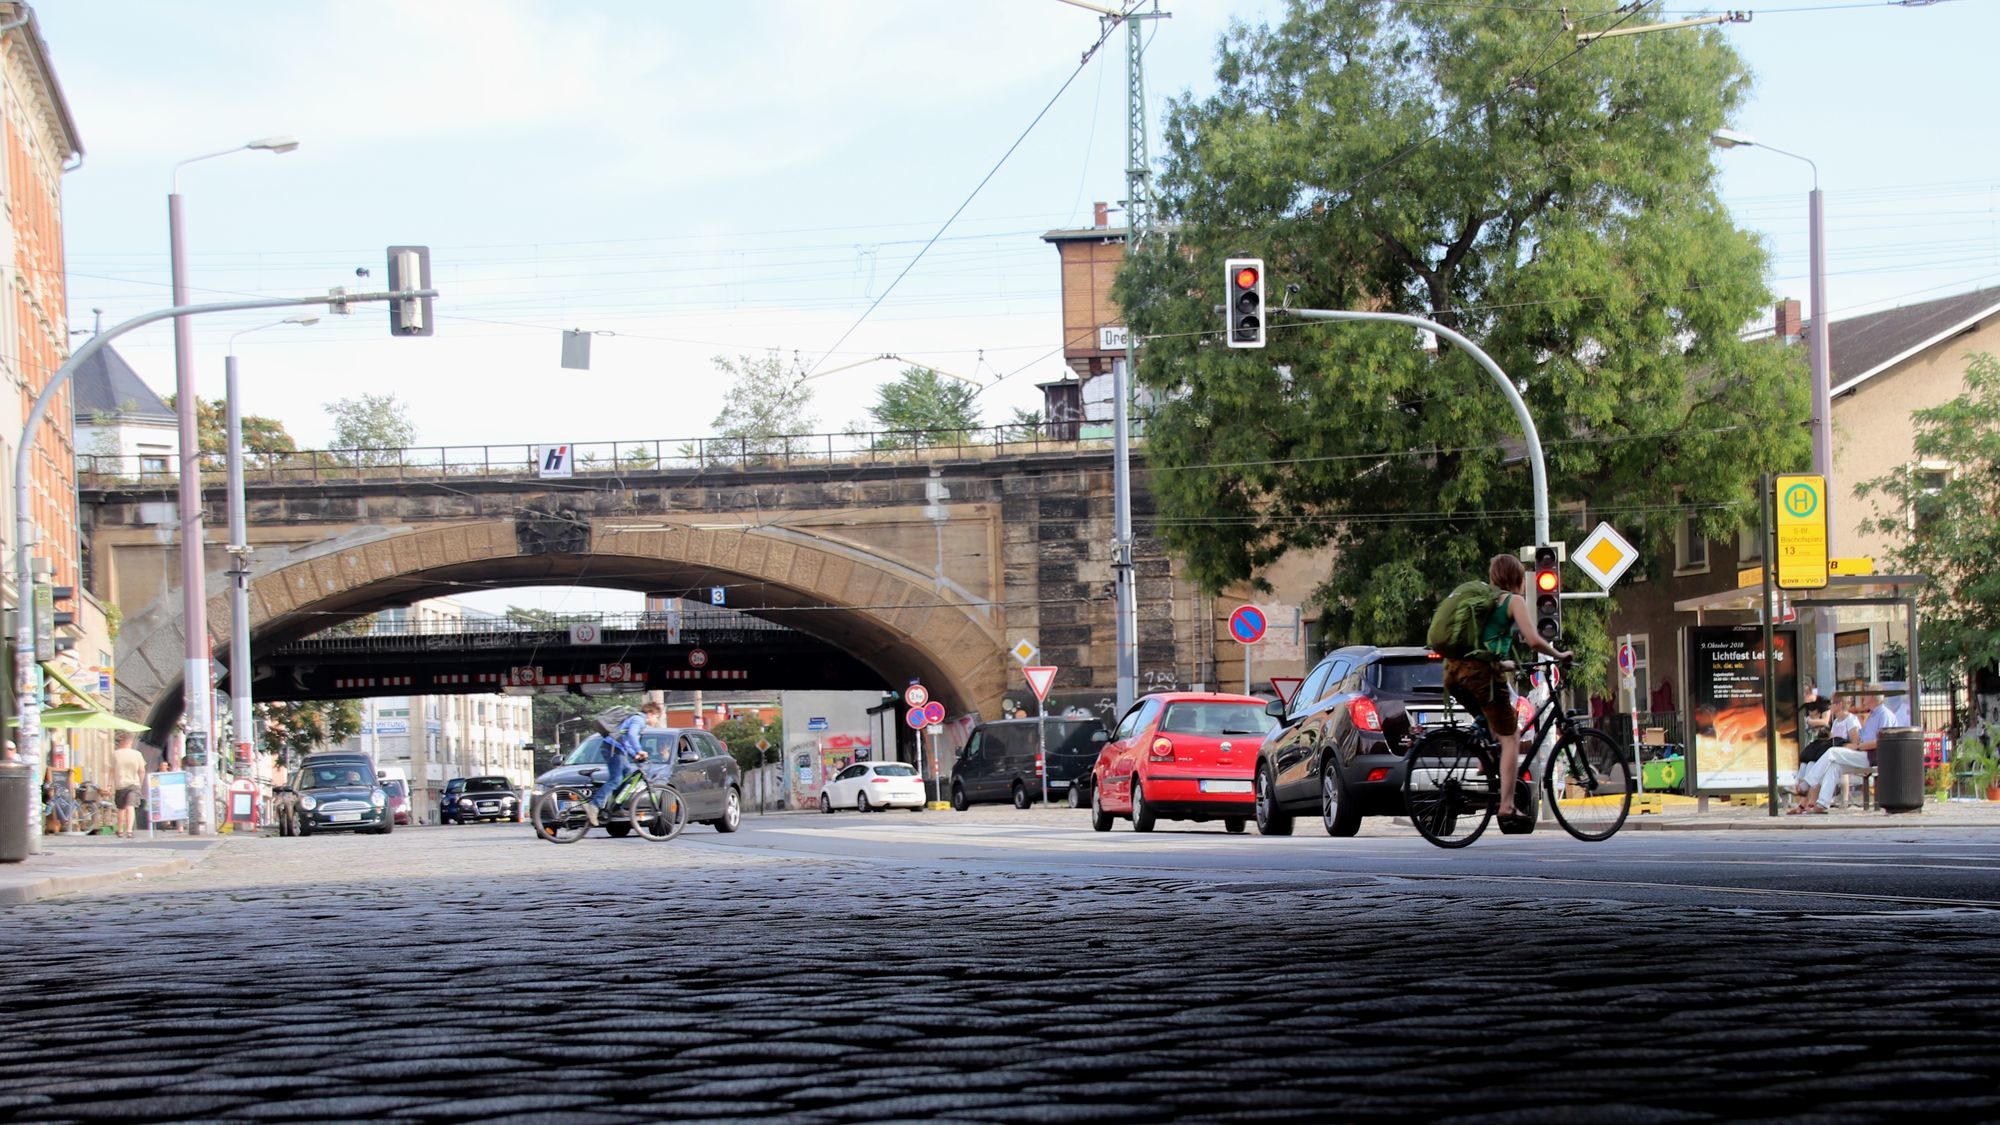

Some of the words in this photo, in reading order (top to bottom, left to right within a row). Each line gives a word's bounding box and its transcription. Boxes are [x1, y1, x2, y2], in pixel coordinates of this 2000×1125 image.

[1785, 546, 1796, 555] 13
[714, 590, 723, 601] 3
[1712, 651, 1750, 661] Lichtfest
[1752, 650, 1784, 661] Leiig
